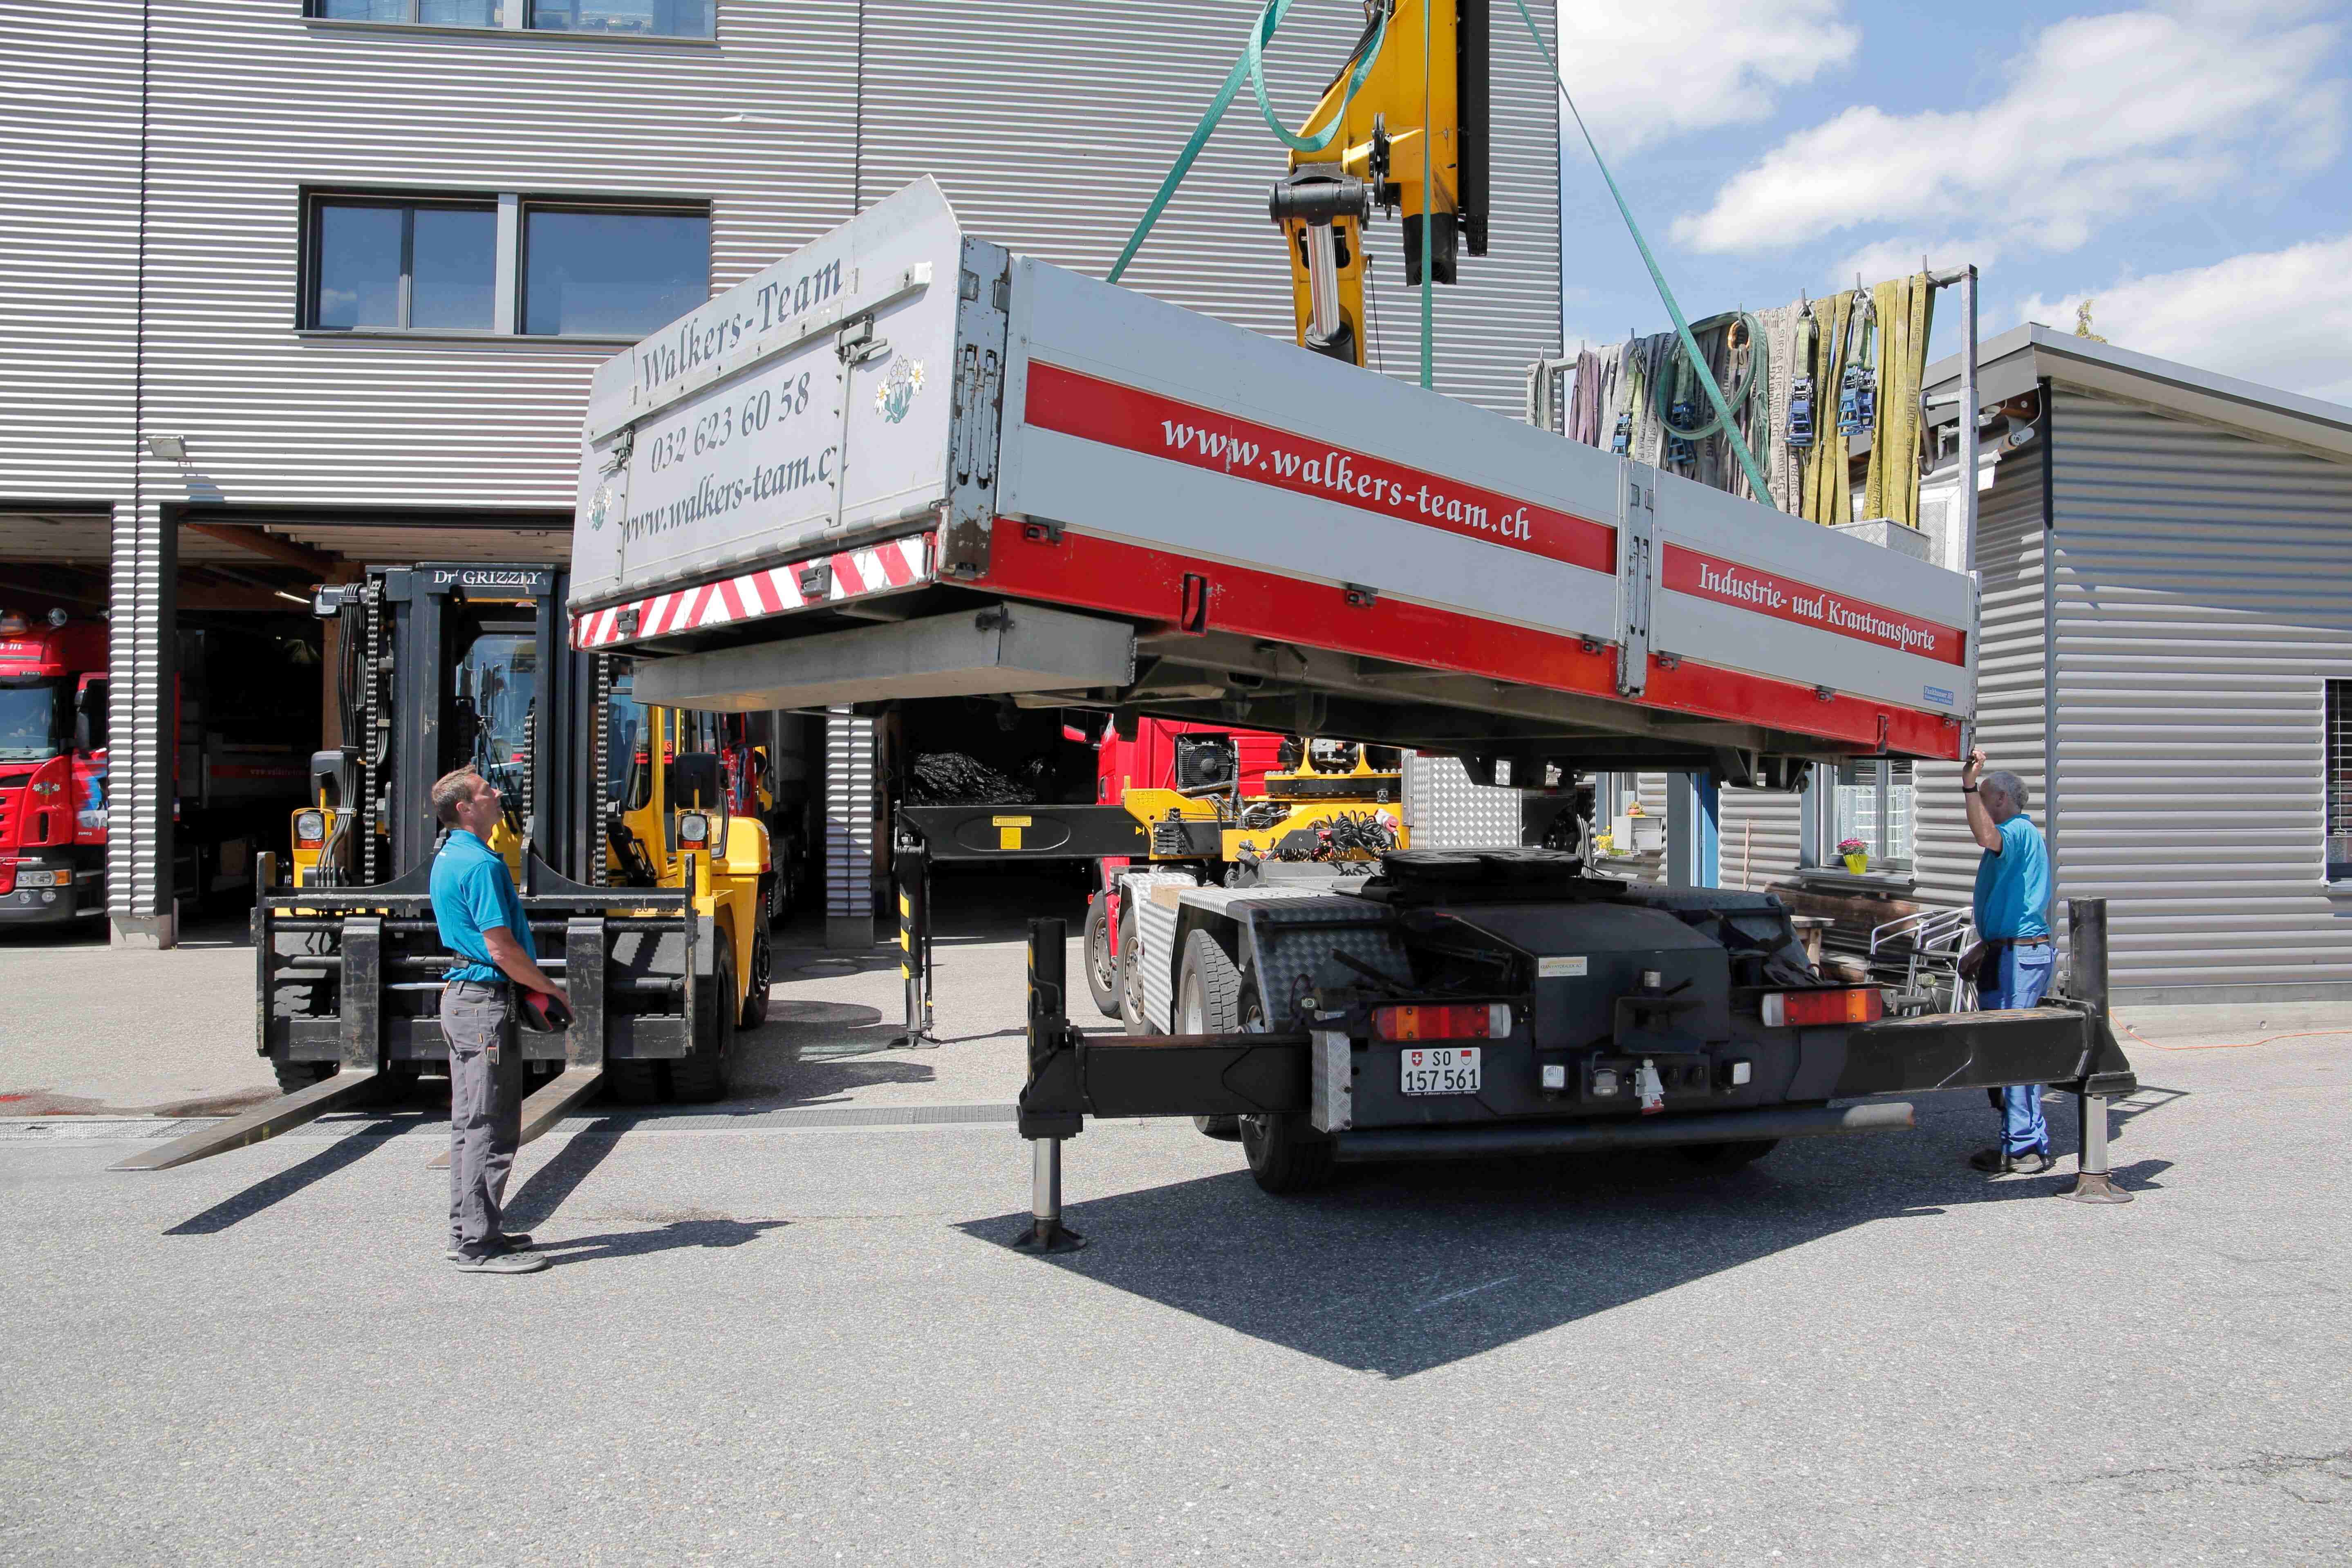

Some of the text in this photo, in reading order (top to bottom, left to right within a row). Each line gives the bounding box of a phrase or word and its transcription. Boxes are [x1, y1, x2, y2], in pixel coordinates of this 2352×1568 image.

[643, 258, 843, 392] Walkers-Team
[652, 372, 810, 474] 032 623 60 58
[623, 448, 842, 543] www.walkers-team.c
[1161, 420, 1531, 540] www.walkers-team.ch
[462, 571, 541, 585] GRIZZLY
[1698, 562, 1935, 651] Industrie- und Krantransporte
[1406, 1068, 1477, 1091] 157 561
[1433, 1051, 1451, 1066] SO
